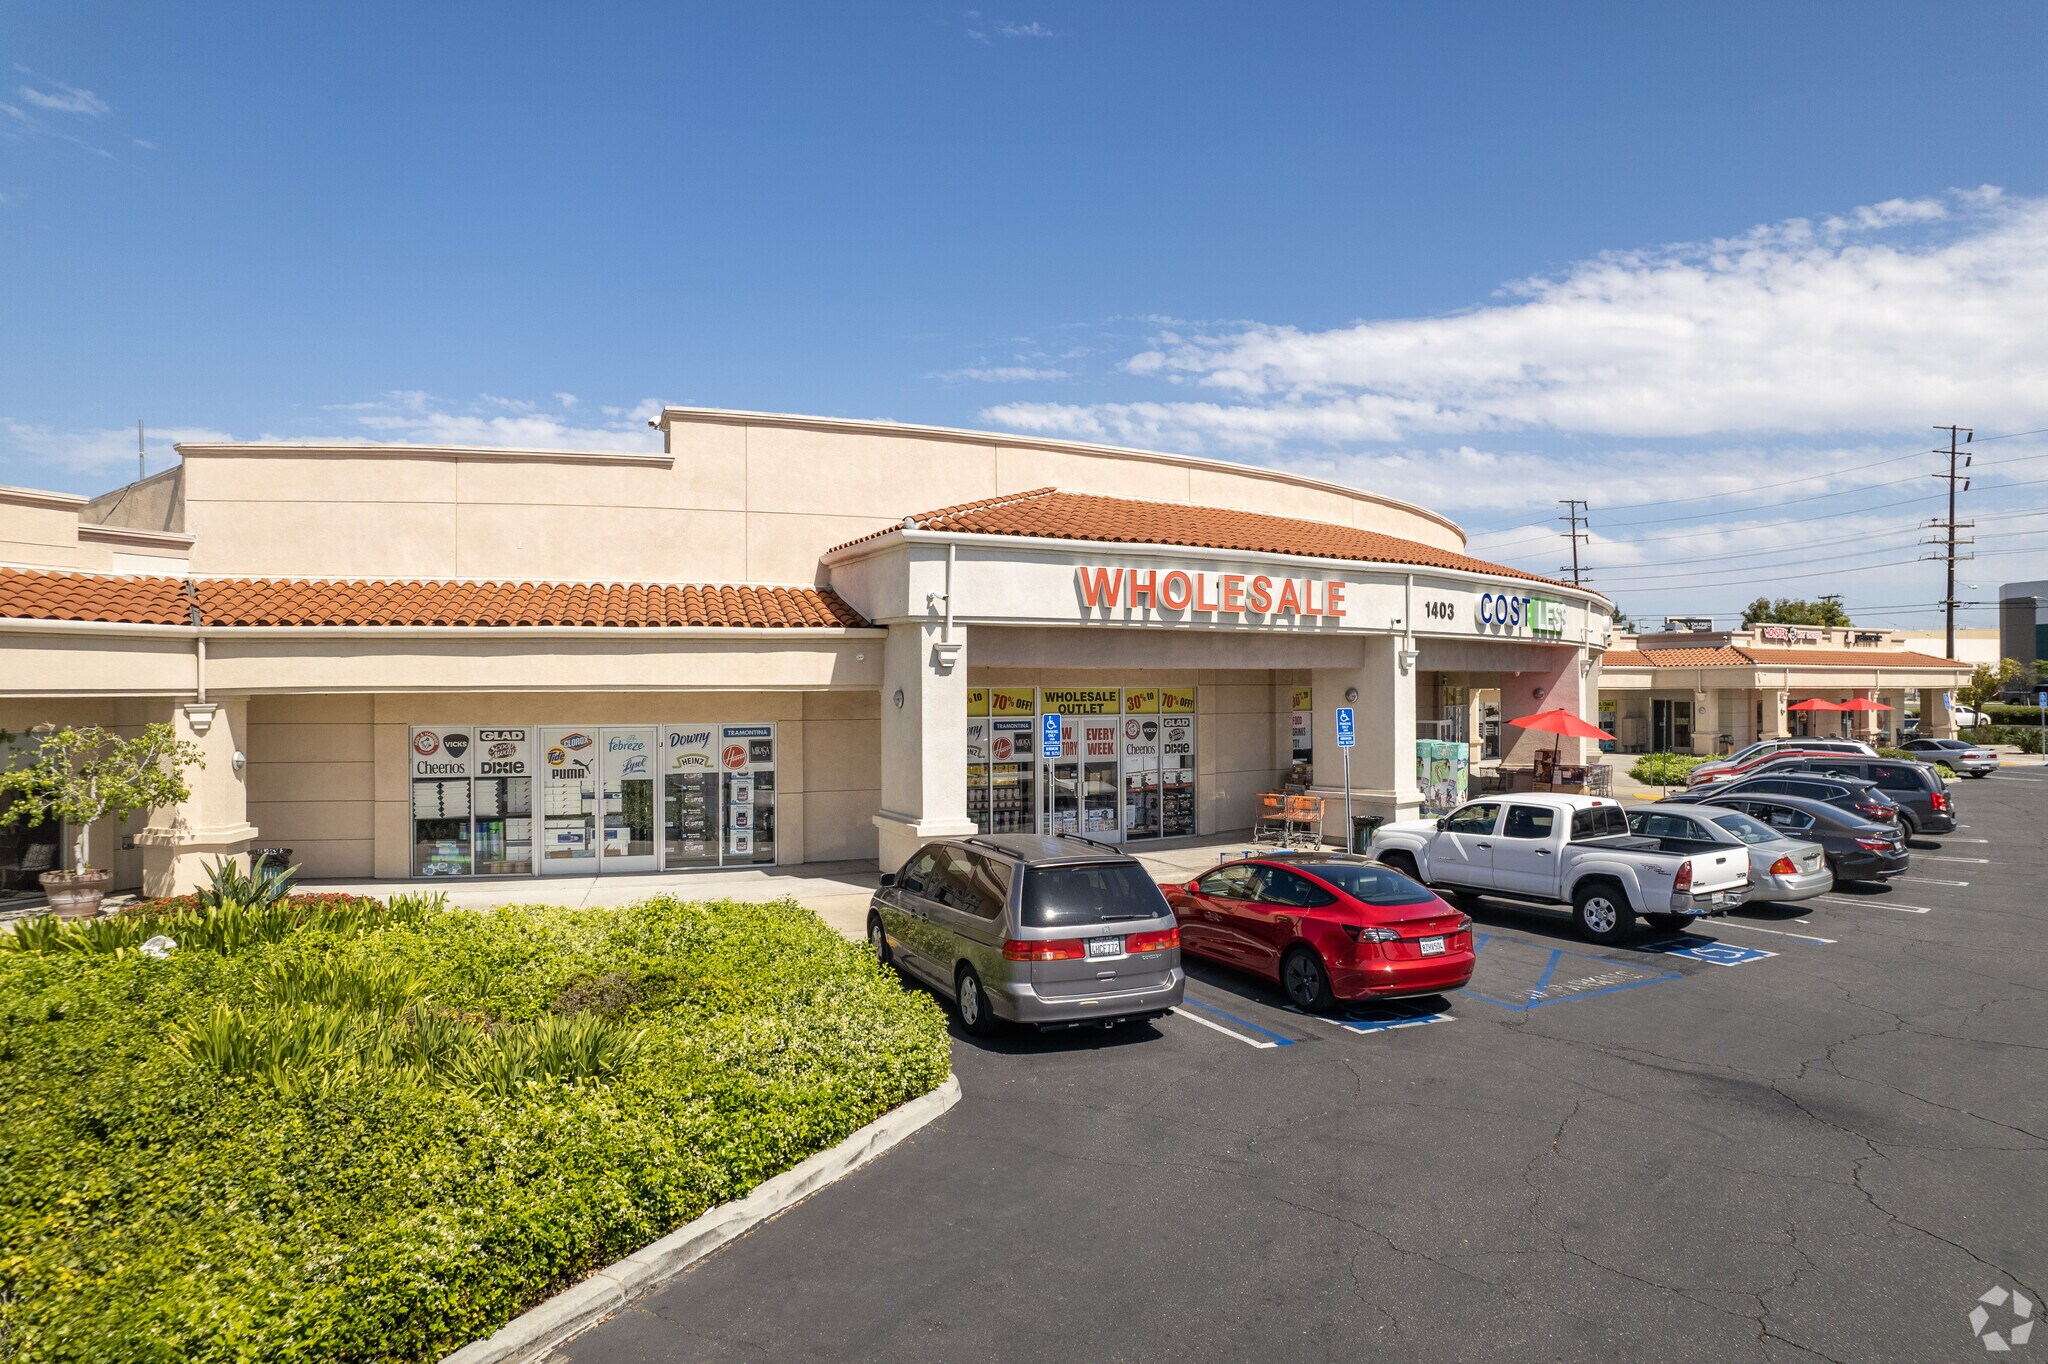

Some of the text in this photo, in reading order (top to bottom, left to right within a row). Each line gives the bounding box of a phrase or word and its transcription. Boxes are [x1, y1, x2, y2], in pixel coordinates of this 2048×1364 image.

[1078, 566, 1347, 617] WHOLESALE
[1425, 601, 1454, 620] 1403
[1480, 593, 1567, 632] COST LESS
[992, 694, 1033, 711] 70% OFF!
[1045, 692, 1116, 702] WHOLESALE
[1127, 693, 1146, 711] 30%
[1162, 693, 1193, 709] 70% OFF!
[1058, 704, 1104, 714] OUTLET
[1164, 719, 1189, 727] GLAD
[481, 731, 524, 741] GLAD
[669, 732, 711, 748] Downy
[1086, 728, 1115, 740] EVERY
[563, 737, 589, 749] CLOROX
[608, 736, 645, 752] febreze
[1061, 742, 1078, 756] TORY
[1087, 743, 1114, 755] WEEK
[547, 751, 566, 764] Tide
[681, 757, 705, 766] HEINZ
[416, 760, 465, 775] Cheerios
[622, 757, 647, 773] Lysol
[552, 769, 585, 779] PUMA
